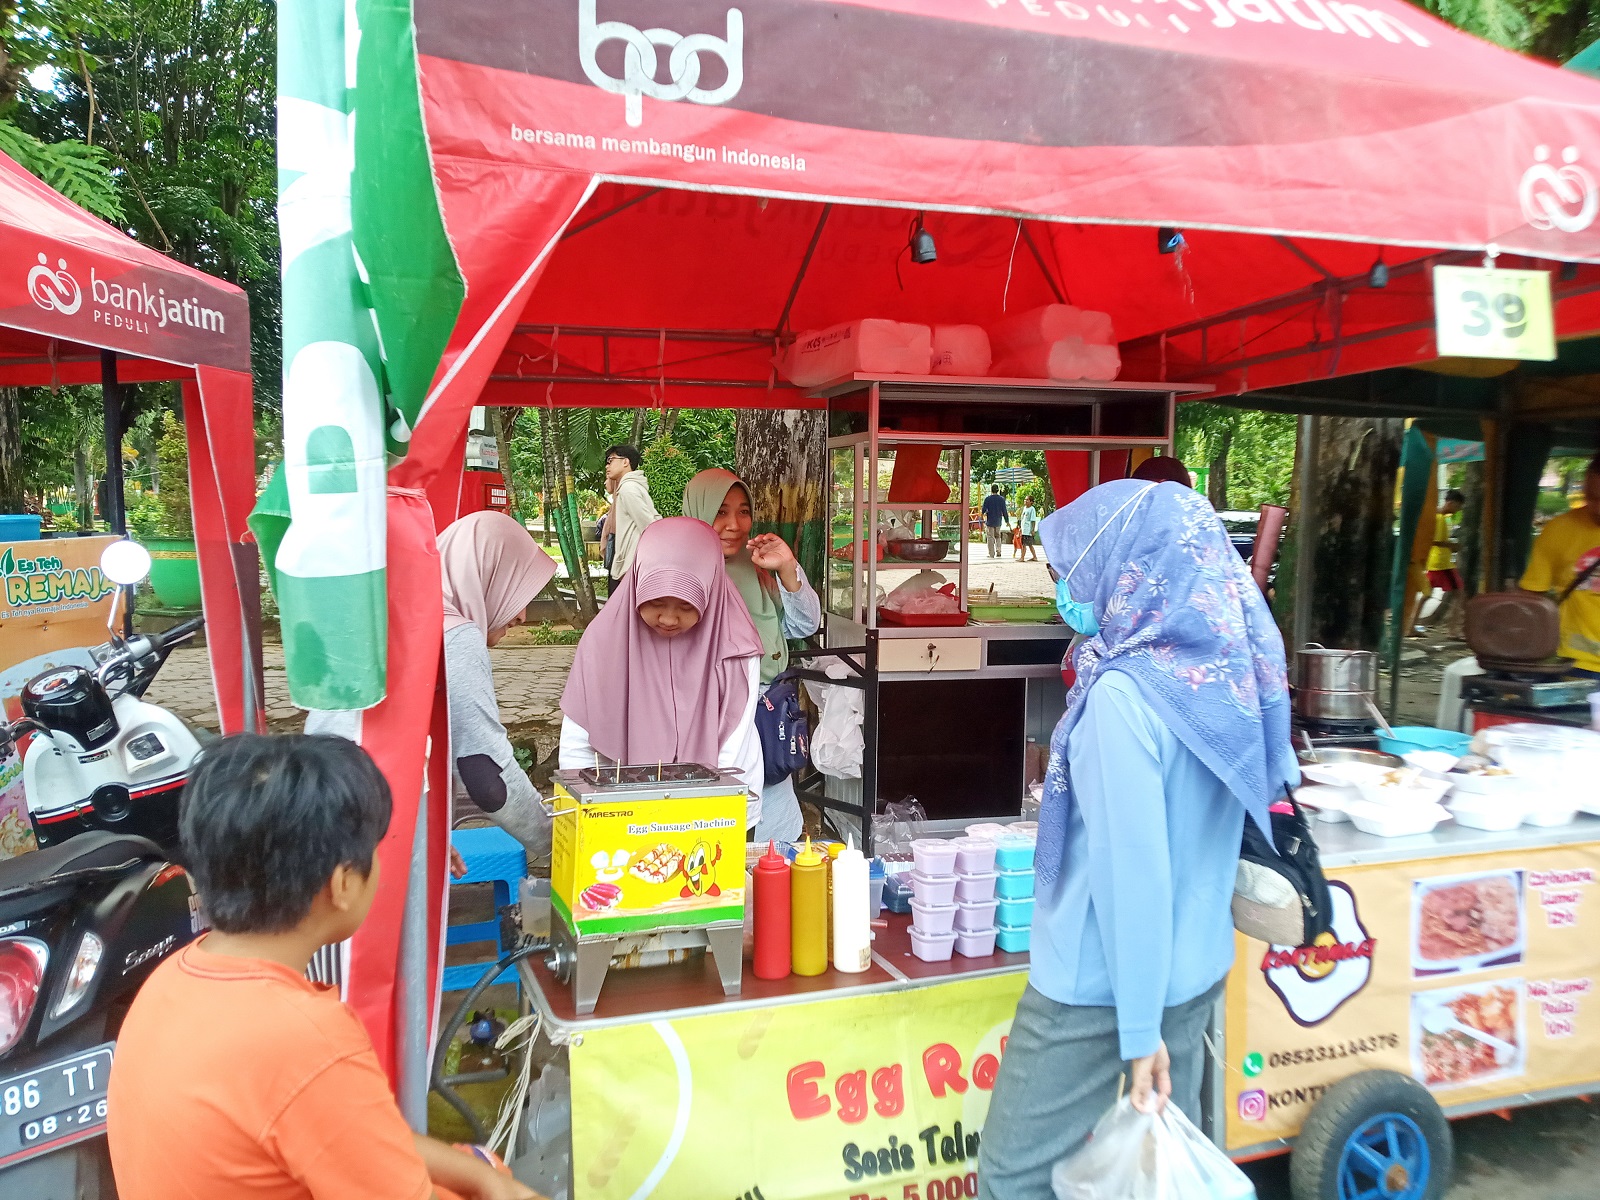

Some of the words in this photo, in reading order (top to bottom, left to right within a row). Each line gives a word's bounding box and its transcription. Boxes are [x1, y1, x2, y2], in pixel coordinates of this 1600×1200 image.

[510, 123, 596, 151] bersama
[602, 135, 717, 163] membangun
[90, 266, 225, 334] bankjatim
[1461, 290, 1528, 339] 39
[93, 309, 149, 335] PEDULI
[17, 558, 35, 573] Es
[36, 556, 62, 571] Teh
[588, 810, 634, 819] MAESTRO
[628, 824, 648, 835] Egg
[650, 822, 691, 833] Sausage
[693, 818, 736, 830] Machine
[0, 1079, 40, 1116] 86
[62, 1060, 97, 1096] TT
[786, 1060, 905, 1125] Egg
[922, 1035, 1010, 1099] Ro
[1267, 1082, 1333, 1110] KONT
